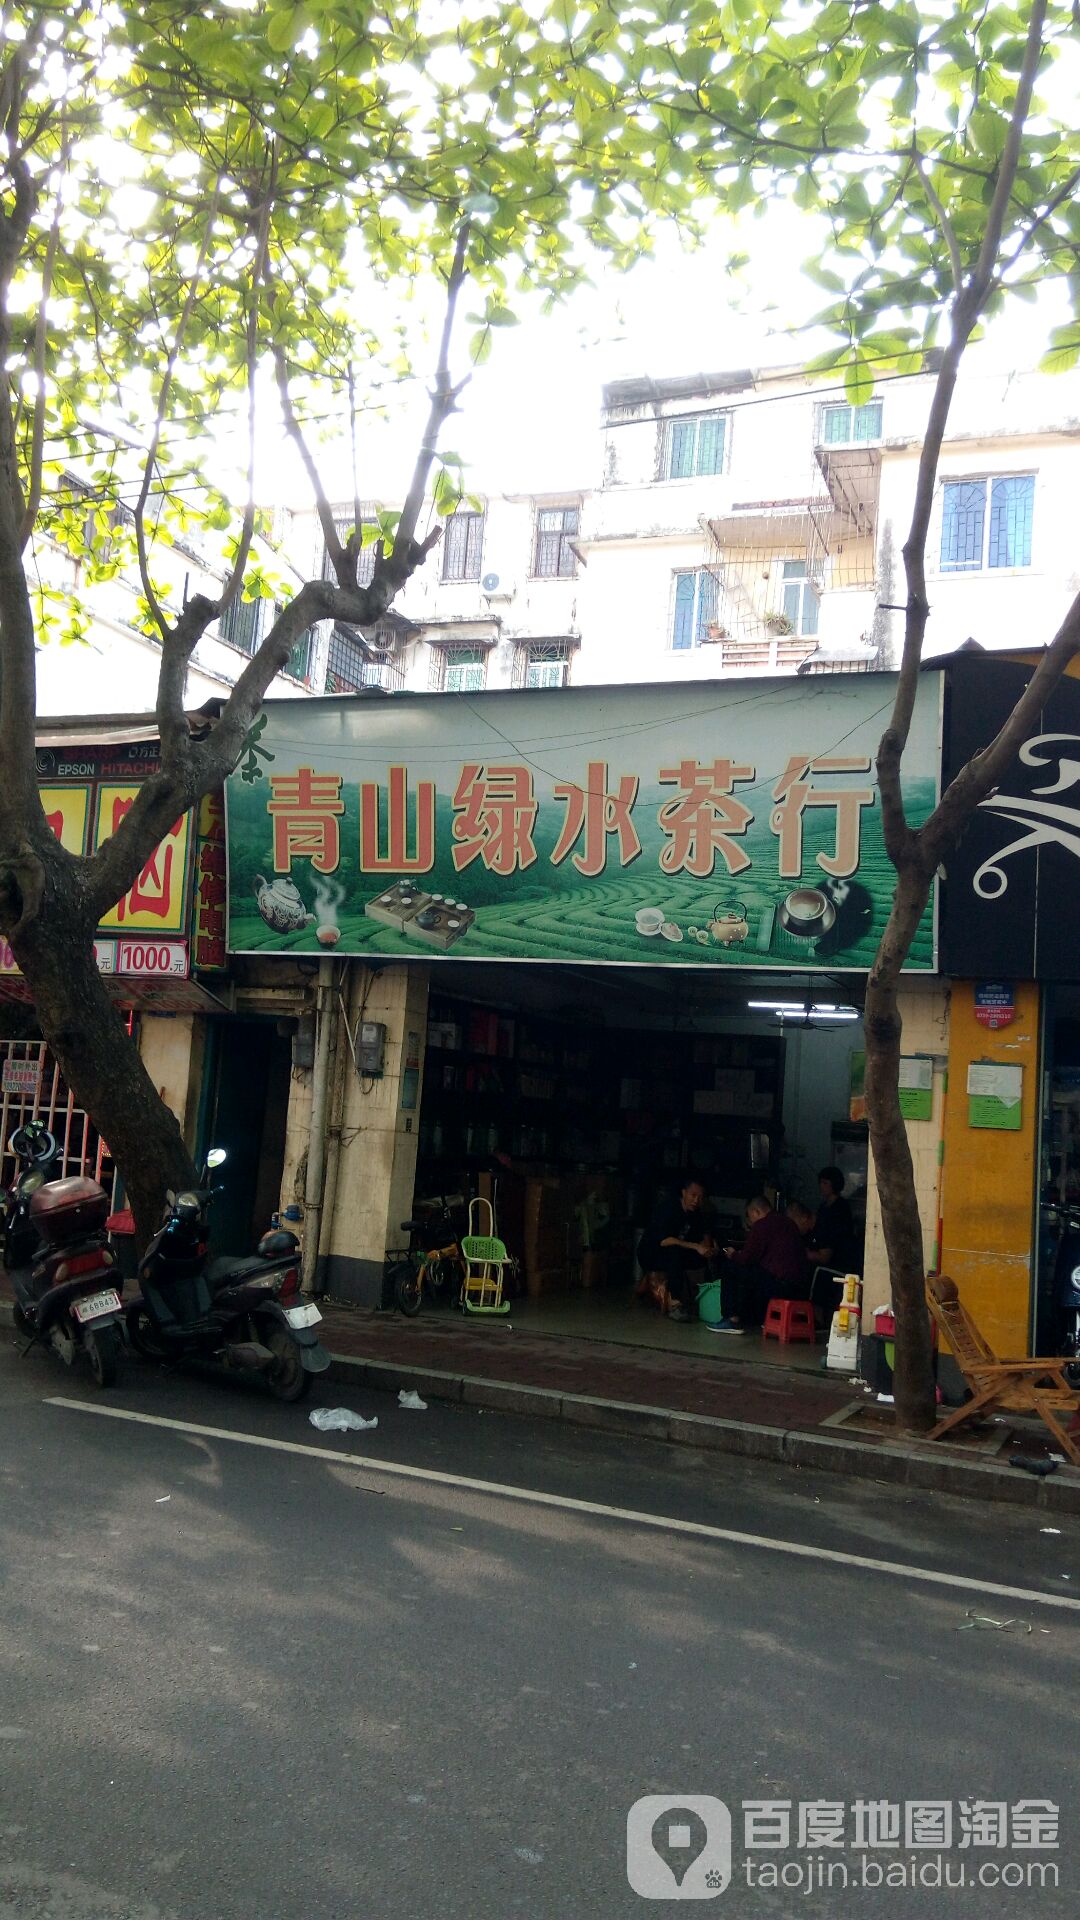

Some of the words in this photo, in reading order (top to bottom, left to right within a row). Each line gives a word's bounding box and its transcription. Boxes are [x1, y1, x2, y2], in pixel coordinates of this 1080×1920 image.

[57, 763, 95, 776] EPSON
[266, 756, 876, 878] 青山绿水茶行
